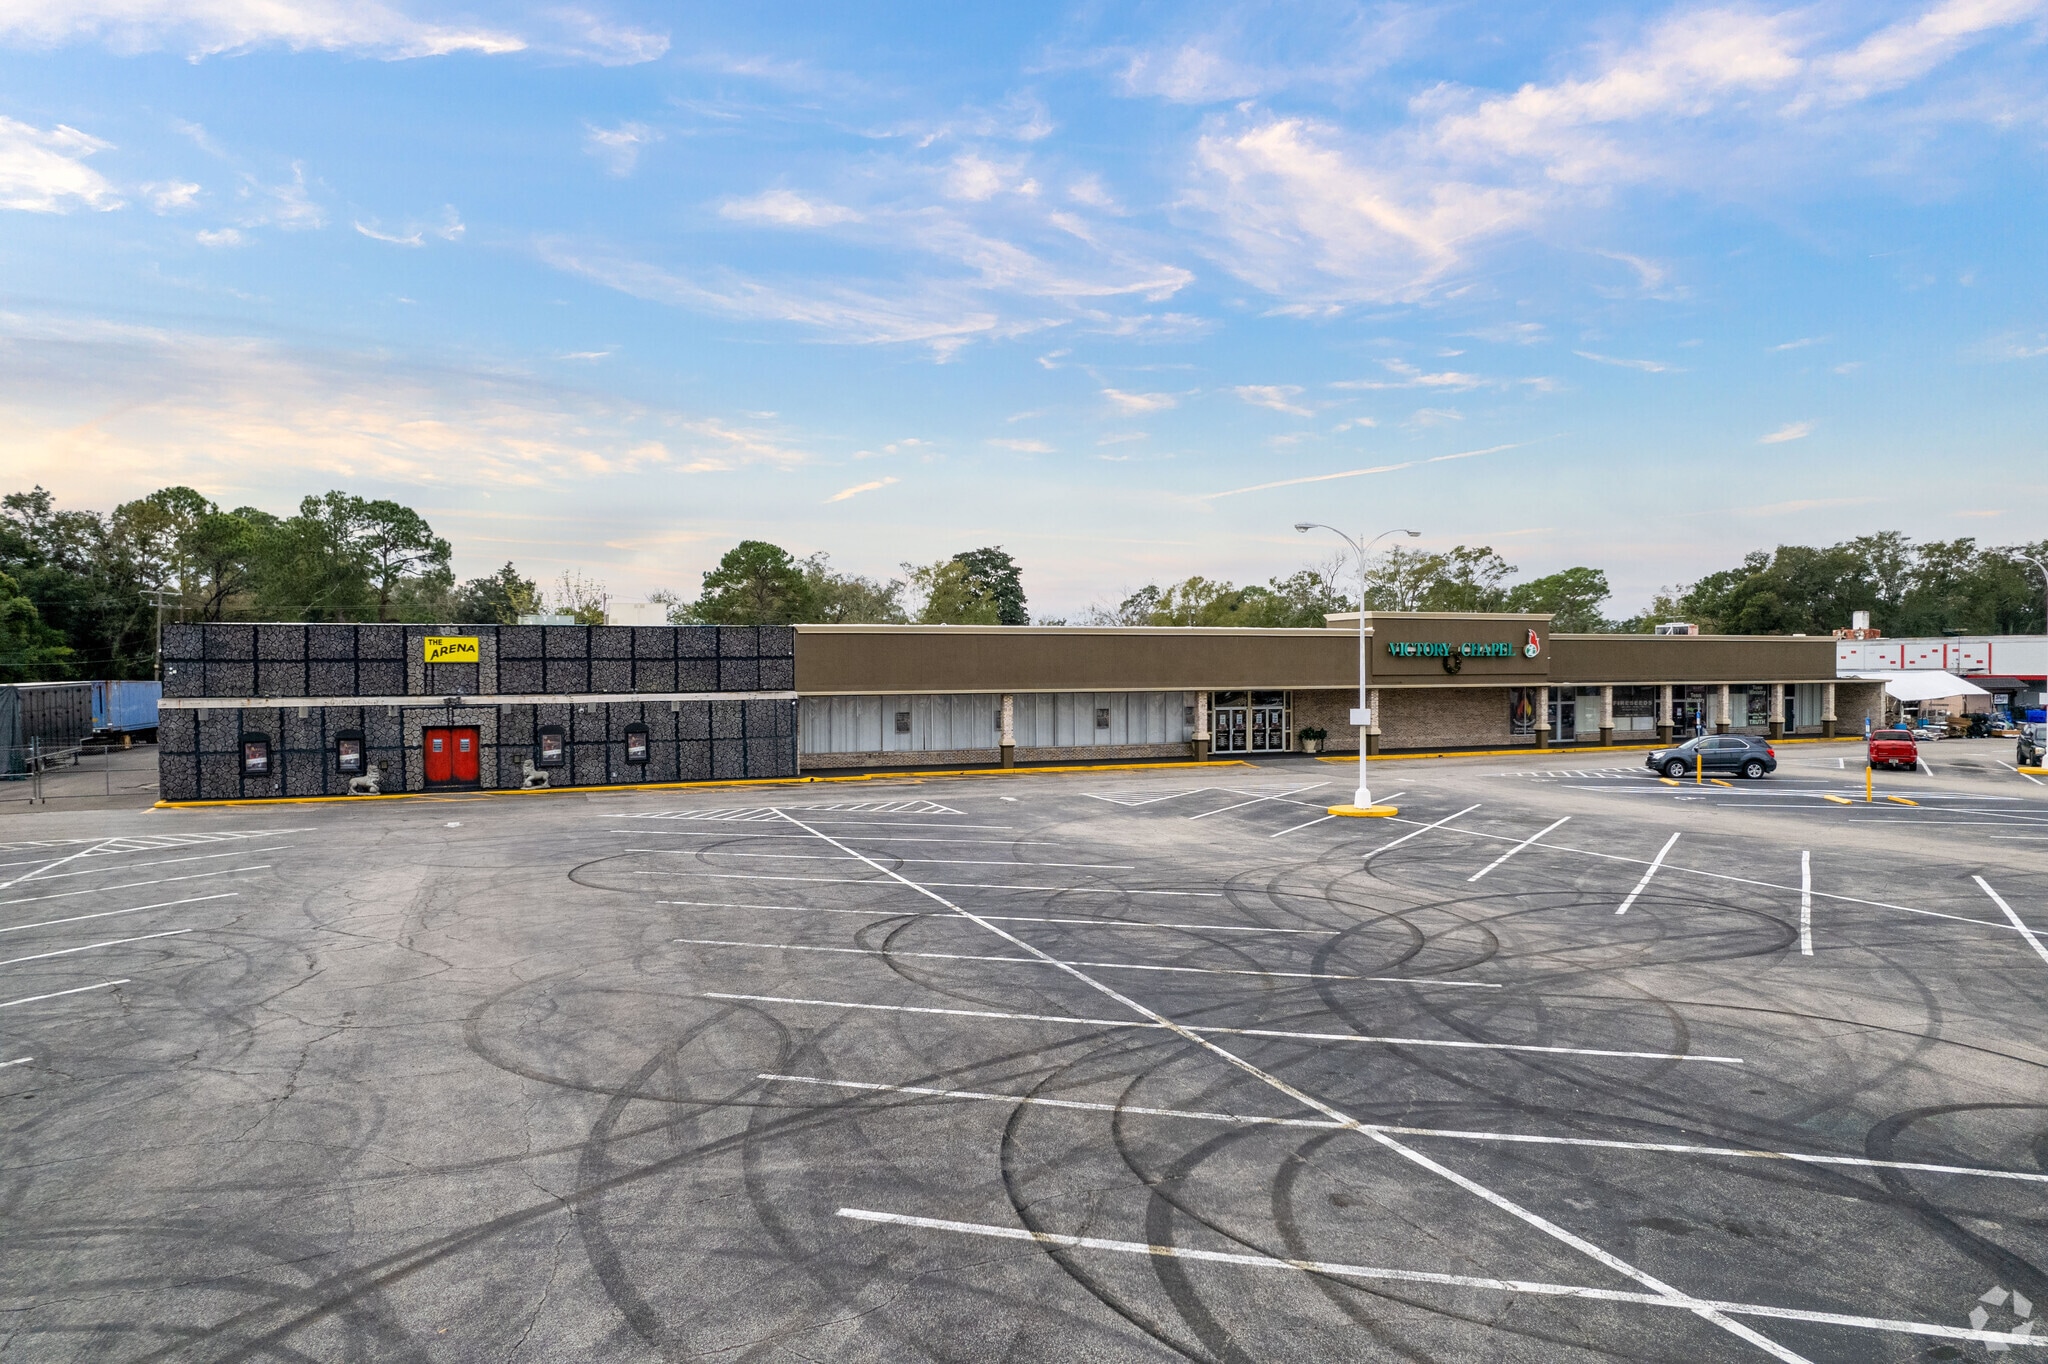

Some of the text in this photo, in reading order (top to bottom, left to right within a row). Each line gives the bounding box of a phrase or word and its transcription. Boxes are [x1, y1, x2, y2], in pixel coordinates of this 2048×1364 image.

[430, 644, 476, 660] ARENA
[1389, 642, 1516, 657] VICTORY CHAPEL
